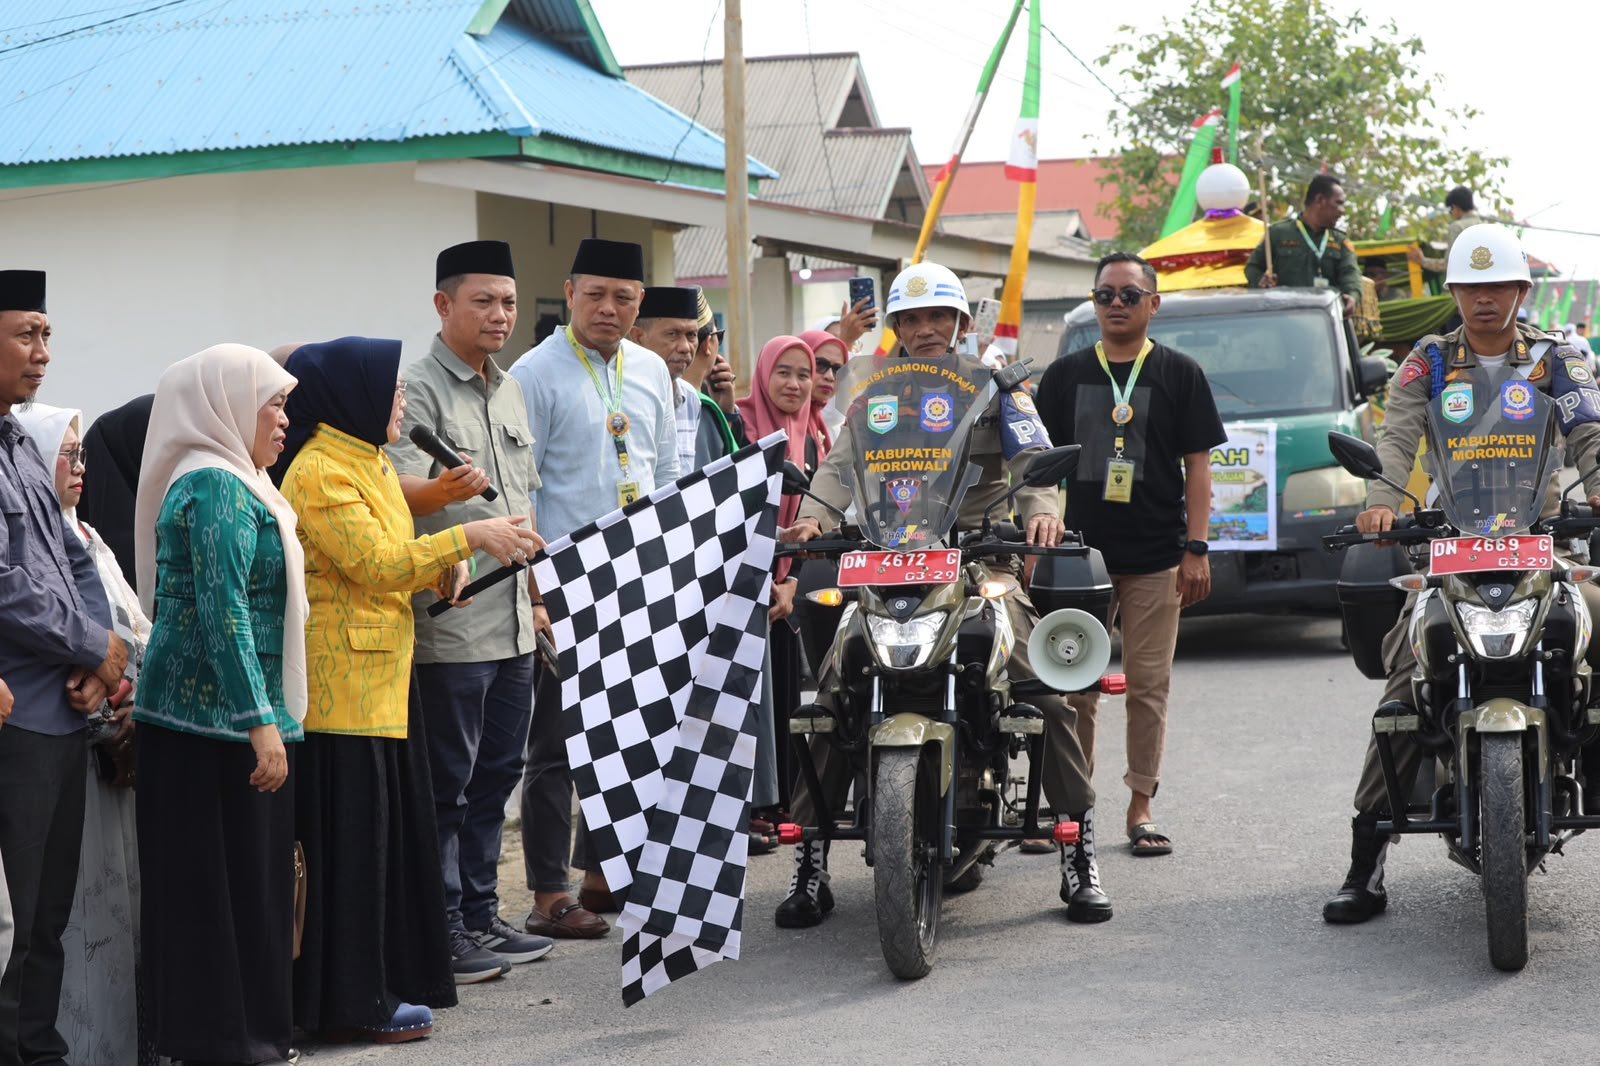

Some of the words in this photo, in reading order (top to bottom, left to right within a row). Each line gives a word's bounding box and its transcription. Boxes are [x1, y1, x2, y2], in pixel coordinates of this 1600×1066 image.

[887, 363, 938, 376] PAMONG
[941, 368, 978, 393] PRAJA
[1447, 435, 1537, 449] KABUPATEN
[865, 447, 953, 461] KABUPATEN
[1452, 447, 1533, 461] MOROWALI
[868, 461, 949, 473] MOROWALI
[892, 479, 915, 488] PTI
[1434, 540, 1457, 557] DN
[1472, 538, 1520, 552] 4669
[1538, 539, 1549, 552] G
[843, 555, 867, 570] DN
[881, 553, 927, 567] 4672
[946, 552, 958, 565] G
